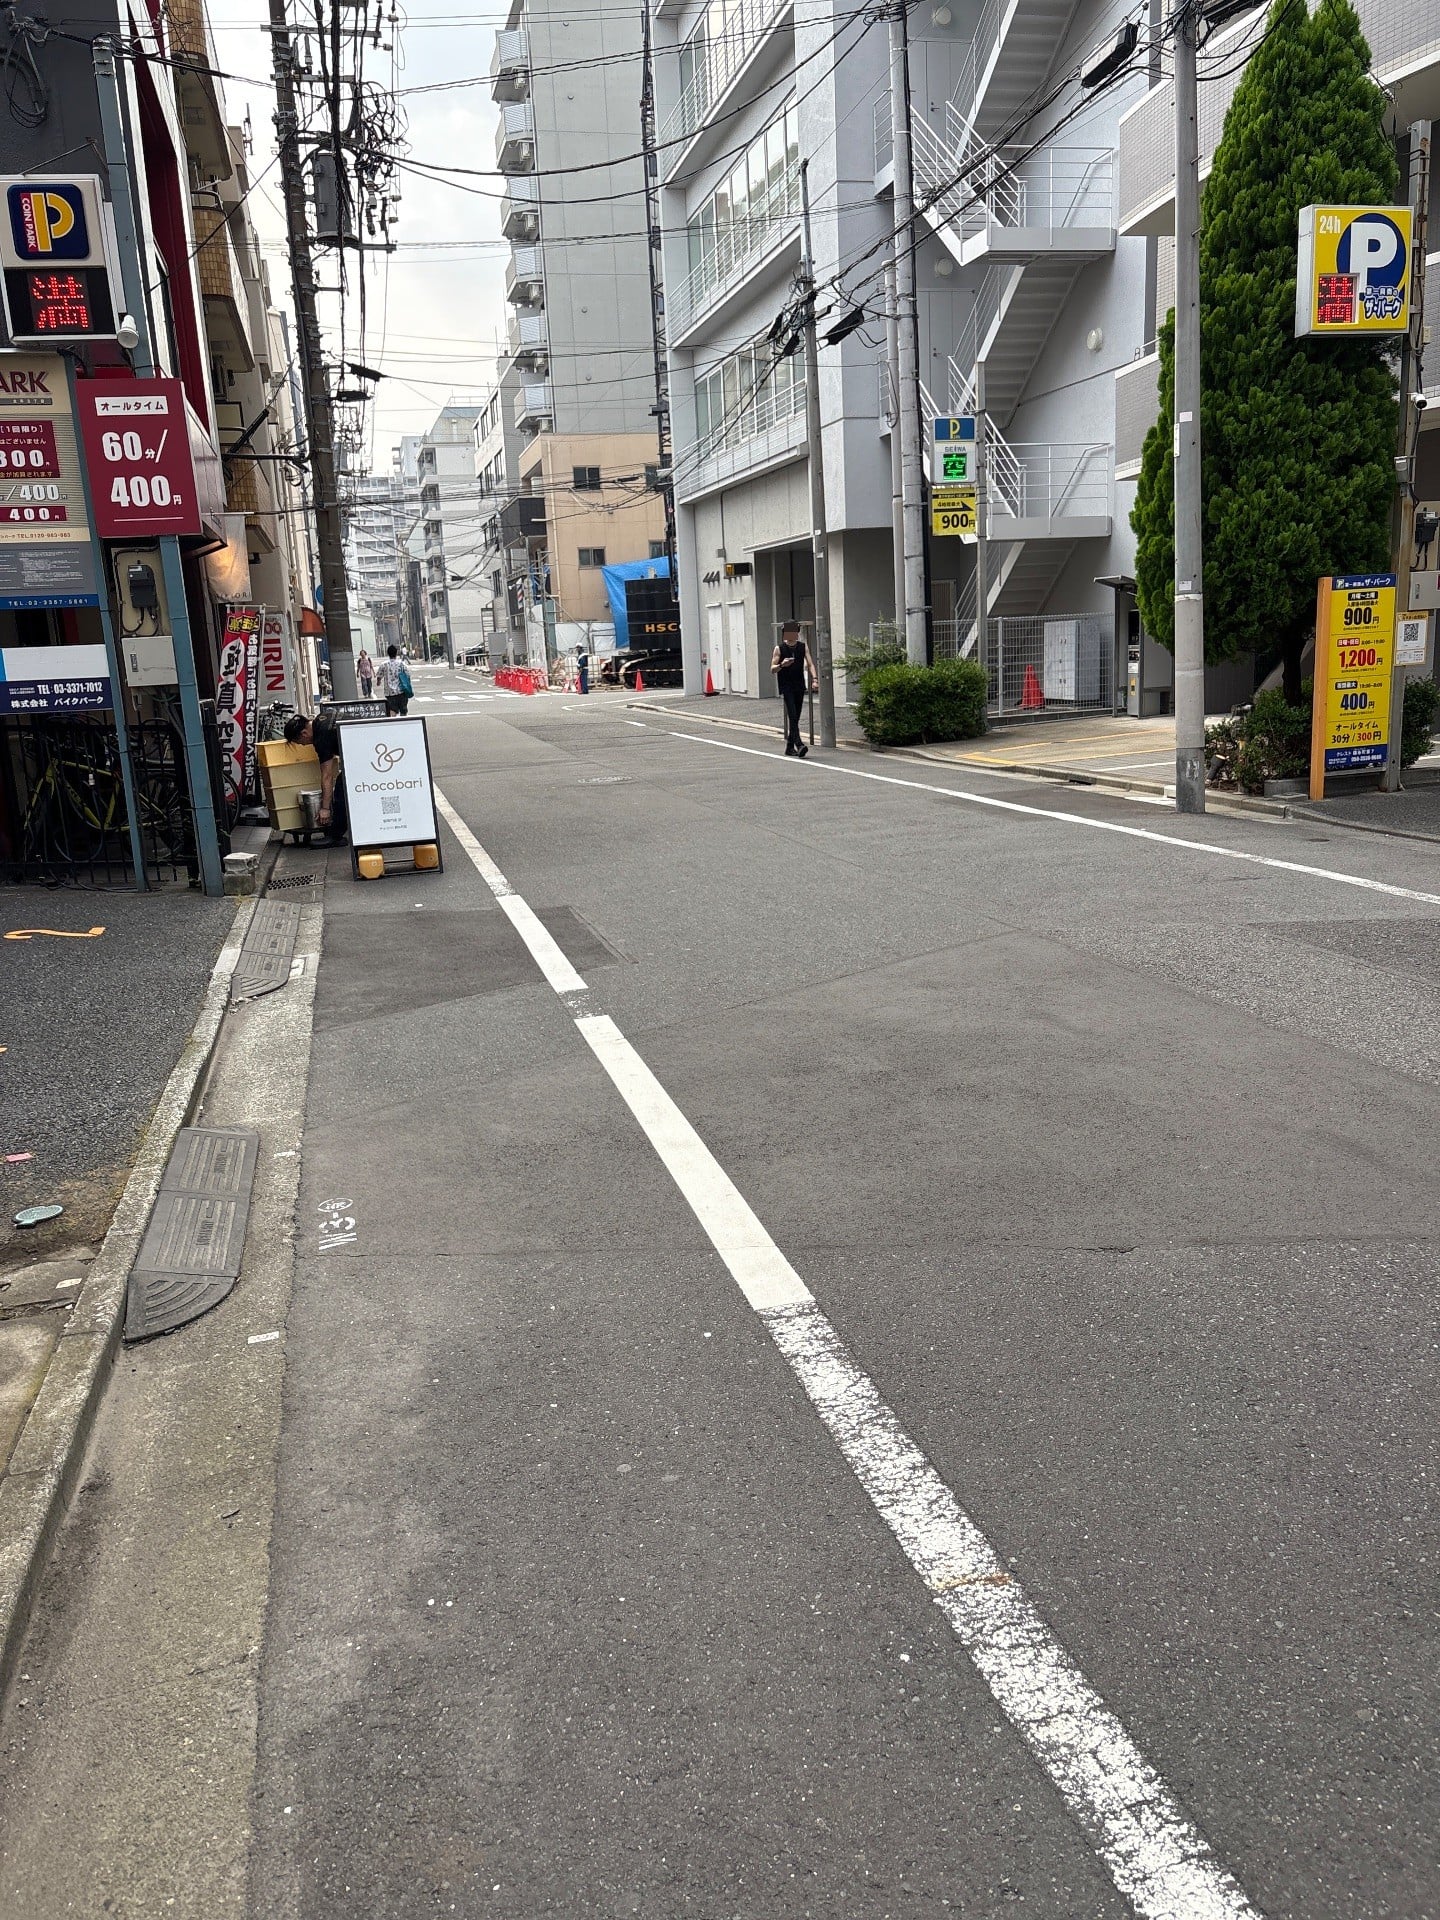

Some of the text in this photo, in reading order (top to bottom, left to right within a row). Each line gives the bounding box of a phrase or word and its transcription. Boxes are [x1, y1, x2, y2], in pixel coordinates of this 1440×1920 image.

[21, 198, 37, 248] COIN PARK
[1319, 215, 1341, 234] 24h
[1350, 222, 1398, 295] P
[100, 400, 164, 412] オールタイム
[110, 475, 183, 507] 400円
[941, 513, 975, 529] 900円
[1343, 606, 1380, 626] 900円
[1338, 648, 1383, 669] 1,200円
[10, 696, 104, 709] 株式会社 バイクパーク
[1340, 691, 1375, 711] 400円
[1335, 721, 1379, 731] オールタイム
[354, 777, 423, 793] chocobari
